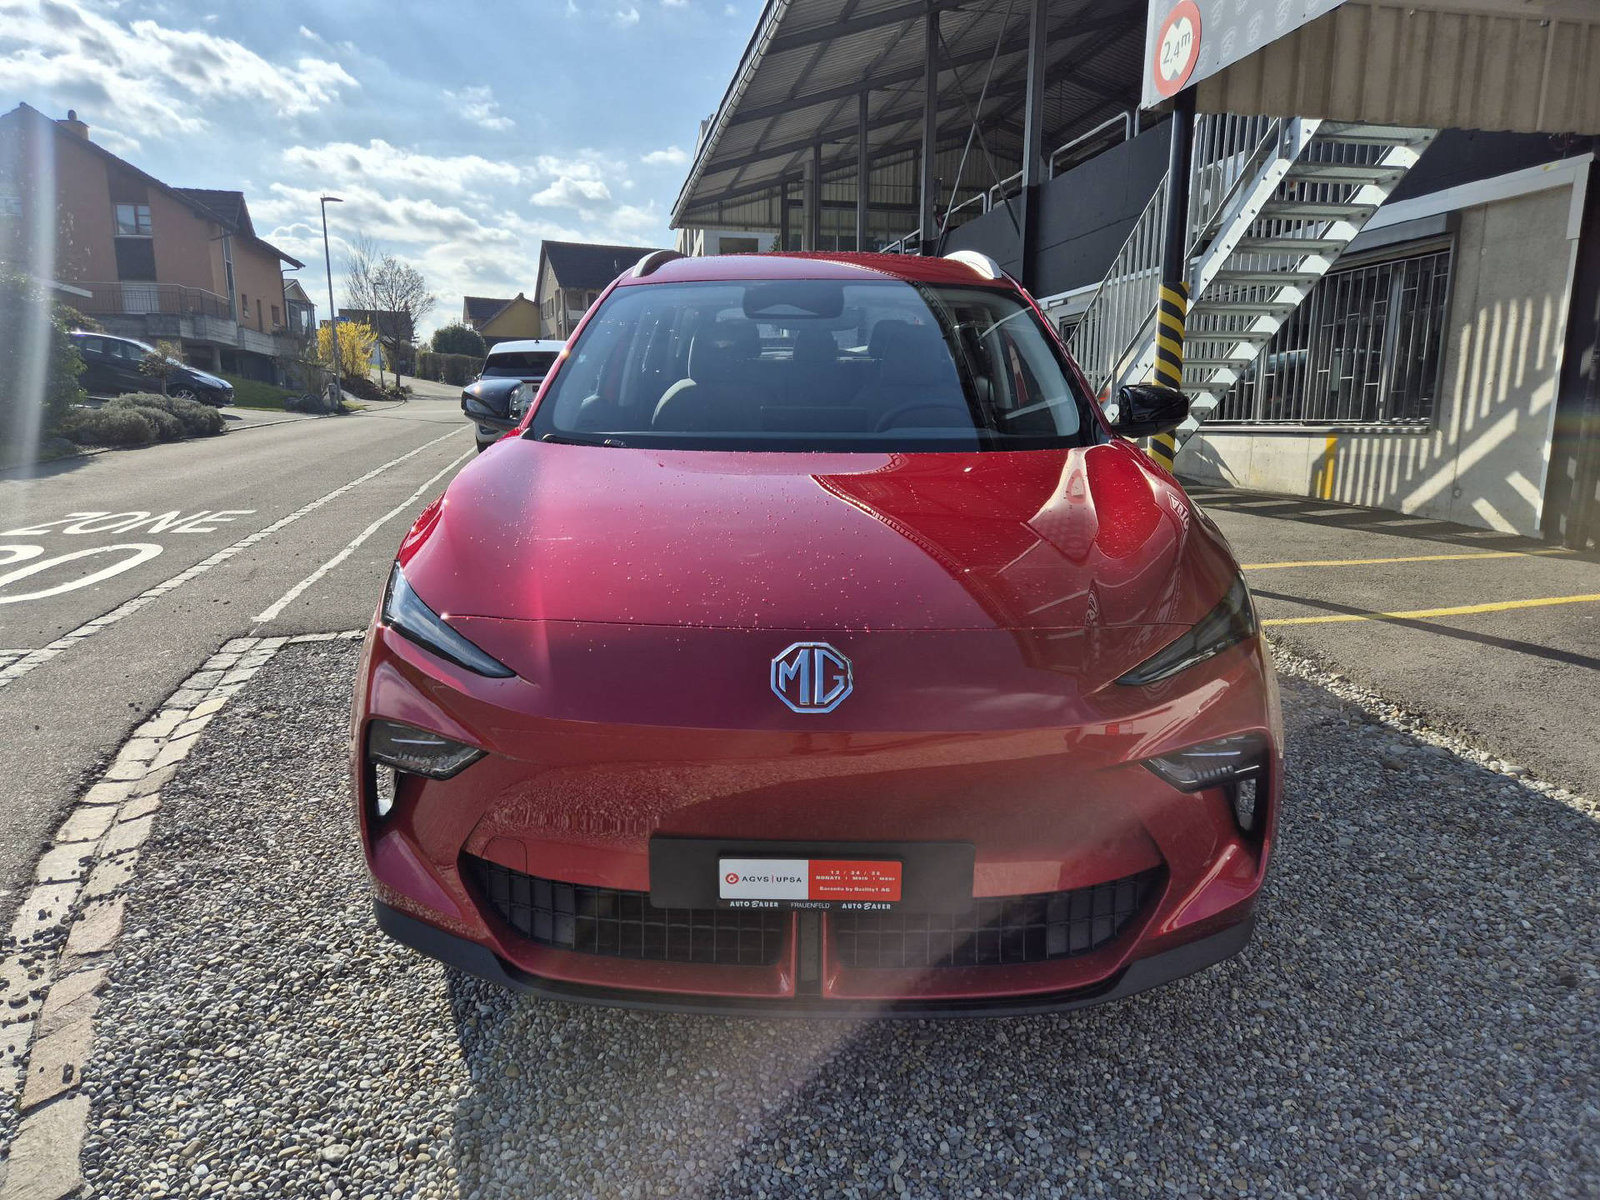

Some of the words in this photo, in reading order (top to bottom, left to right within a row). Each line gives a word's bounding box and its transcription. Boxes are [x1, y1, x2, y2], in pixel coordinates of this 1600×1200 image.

[0, 510, 256, 535] ZONE
[0, 543, 163, 604] 0
[779, 648, 845, 705] MG
[790, 901, 830, 909] FRAUENFELD
